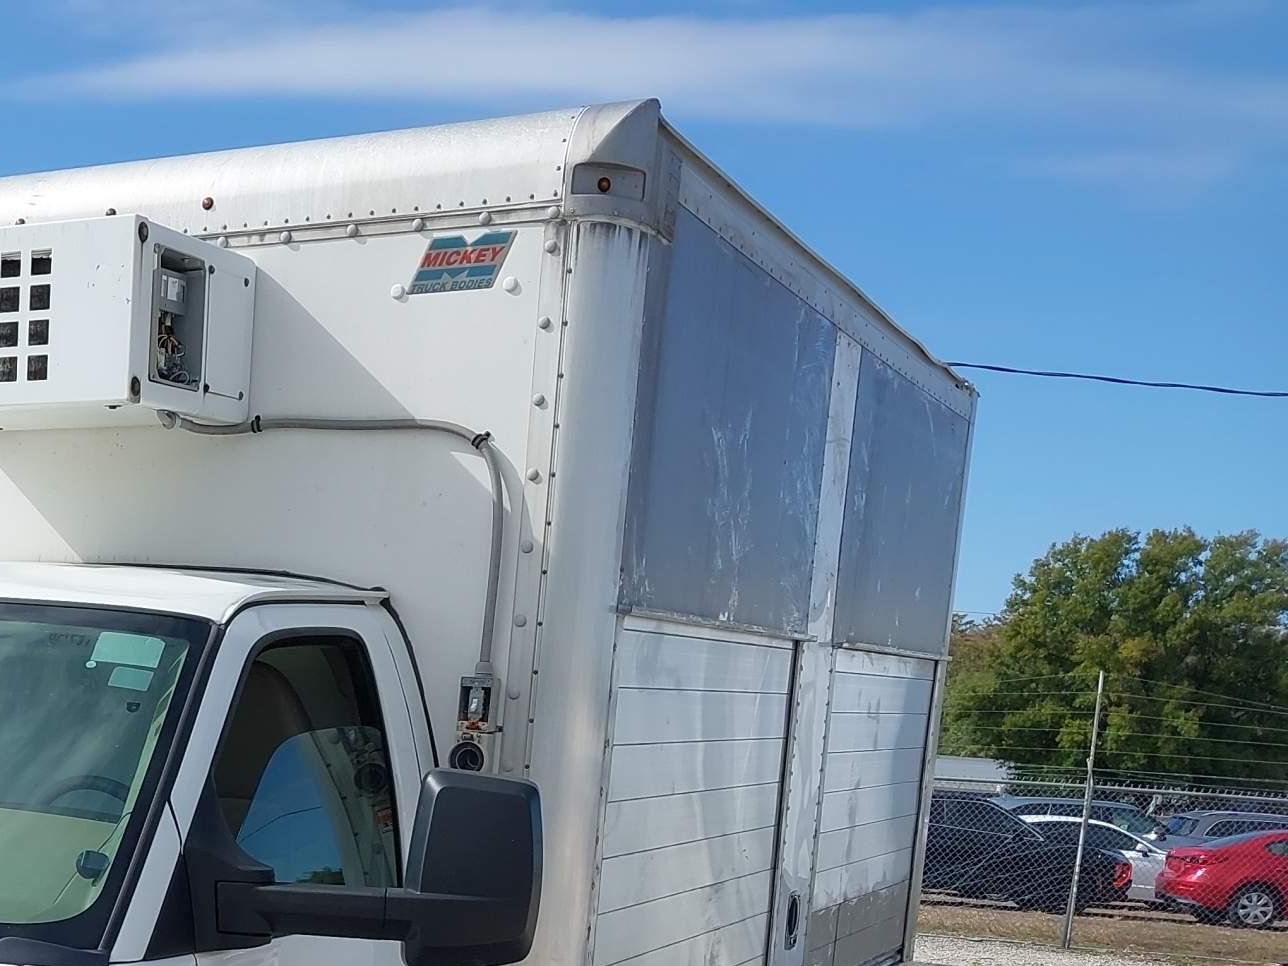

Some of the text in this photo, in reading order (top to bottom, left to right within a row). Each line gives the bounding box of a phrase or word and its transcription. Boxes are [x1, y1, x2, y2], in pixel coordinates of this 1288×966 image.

[420, 246, 505, 269] MICKEY
[411, 277, 493, 294] TRUCK BODIES
